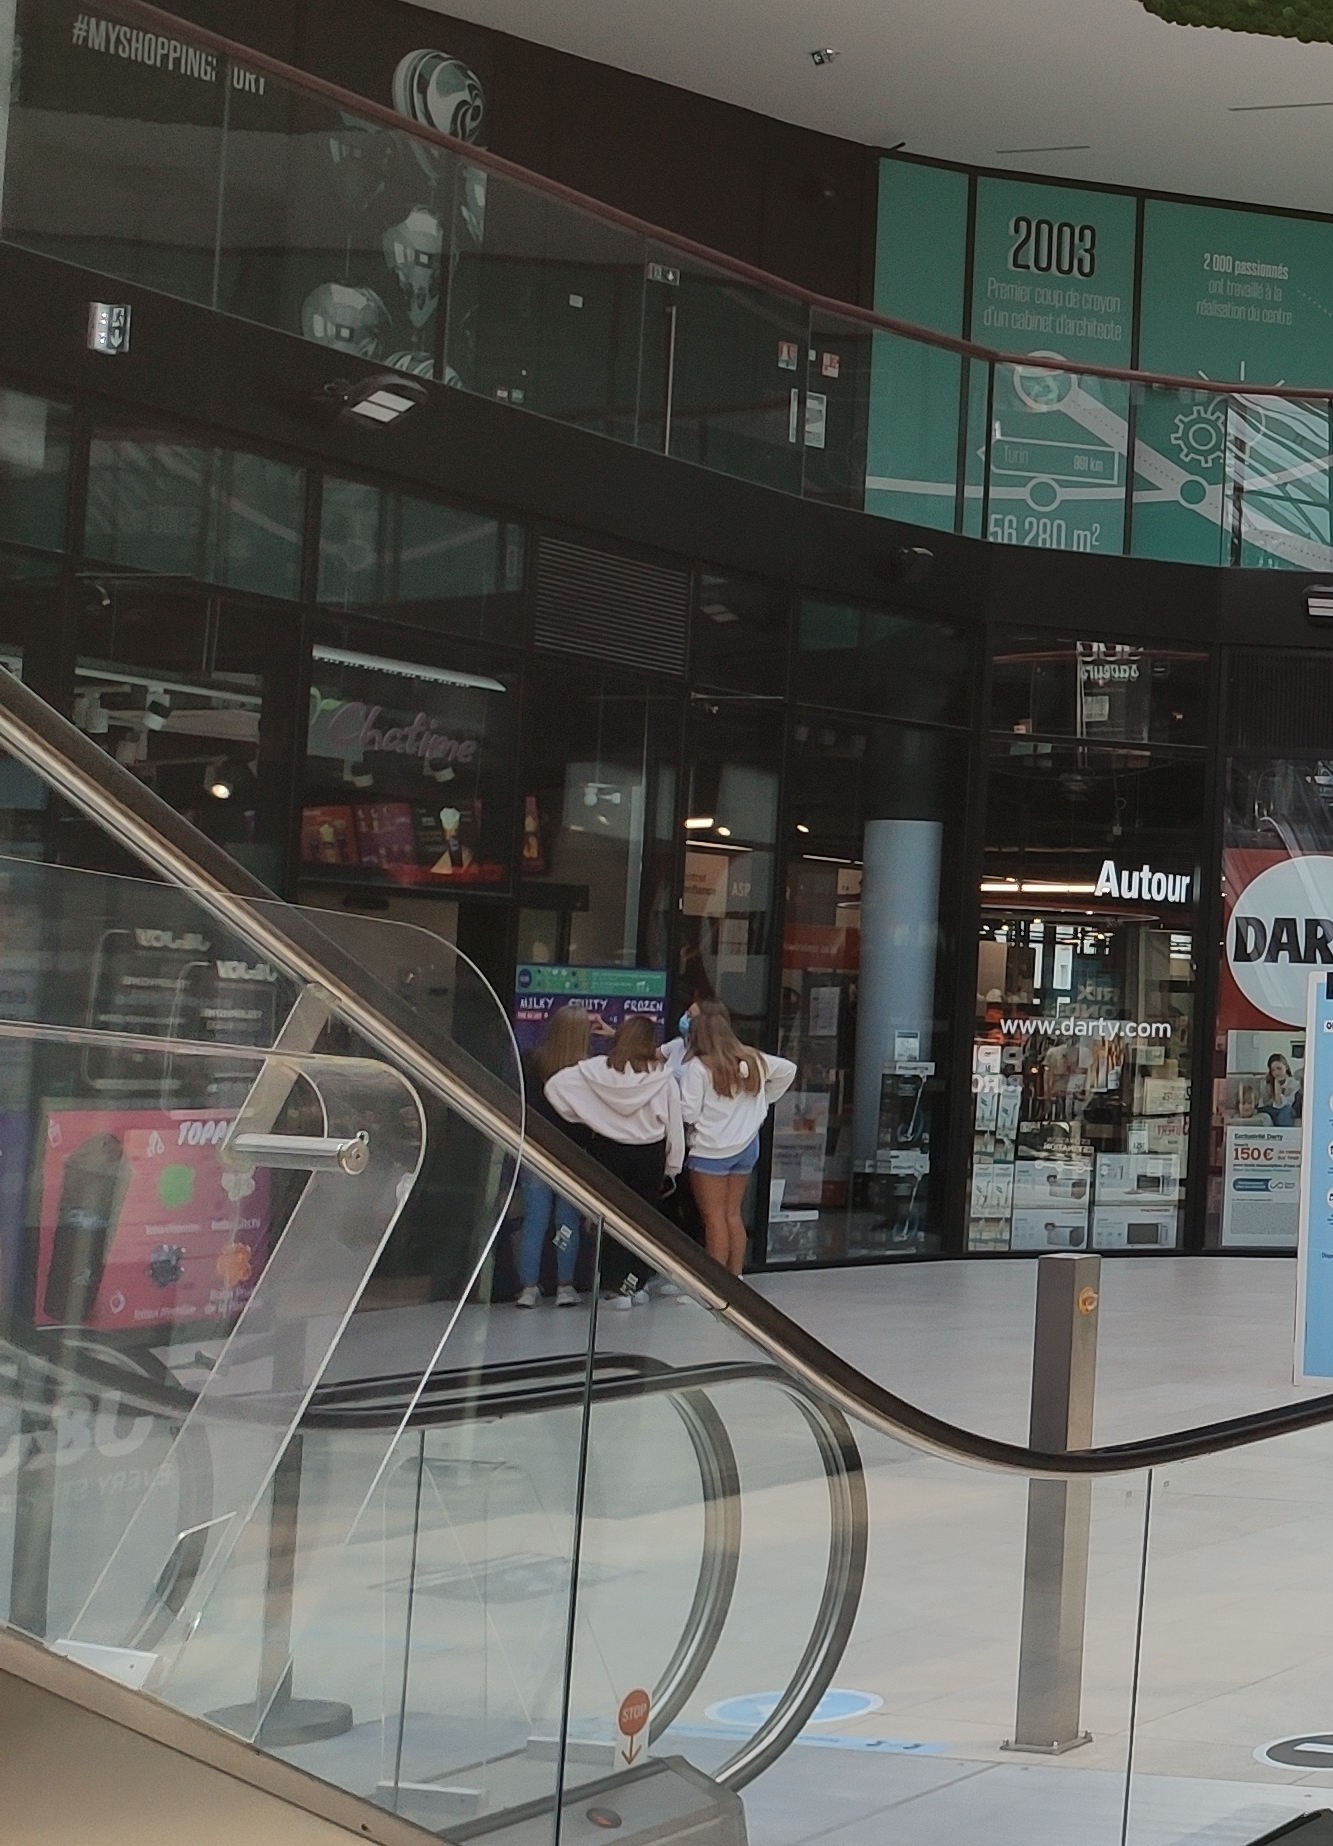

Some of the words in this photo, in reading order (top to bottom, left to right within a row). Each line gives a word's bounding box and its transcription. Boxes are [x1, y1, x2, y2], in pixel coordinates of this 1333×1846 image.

[1010, 216, 1096, 278] 2003
[1203, 253, 1211, 269] 2
[1212, 255, 1233, 273] 000
[1235, 259, 1289, 280] passionnés
[988, 277, 1032, 302] Premier
[1034, 284, 1062, 308] coup
[1066, 285, 1080, 306] de
[1083, 291, 1121, 314] crayon
[1208, 280, 1223, 295] ont
[1226, 280, 1262, 299] travaillé
[1274, 284, 1283, 301] la
[984, 305, 1009, 329] d'un
[1011, 308, 1053, 334] cabinet
[1056, 314, 1122, 341] d'architecte
[1197, 300, 1248, 320] réalisation
[1250, 303, 1260, 321] du
[1262, 308, 1292, 325] centre
[1090, 457, 1103, 472] km
[988, 514, 1016, 544] 56
[1025, 519, 1065, 549] 280
[329, 702, 478, 764] Chatime
[1094, 860, 1191, 903] Autour
[519, 997, 554, 1009] MILKY
[623, 999, 663, 1013] FROZEN
[999, 1016, 1172, 1041] www.darty.com
[178, 1121, 231, 1146] TOPP
[622, 1702, 647, 1723] STOP
